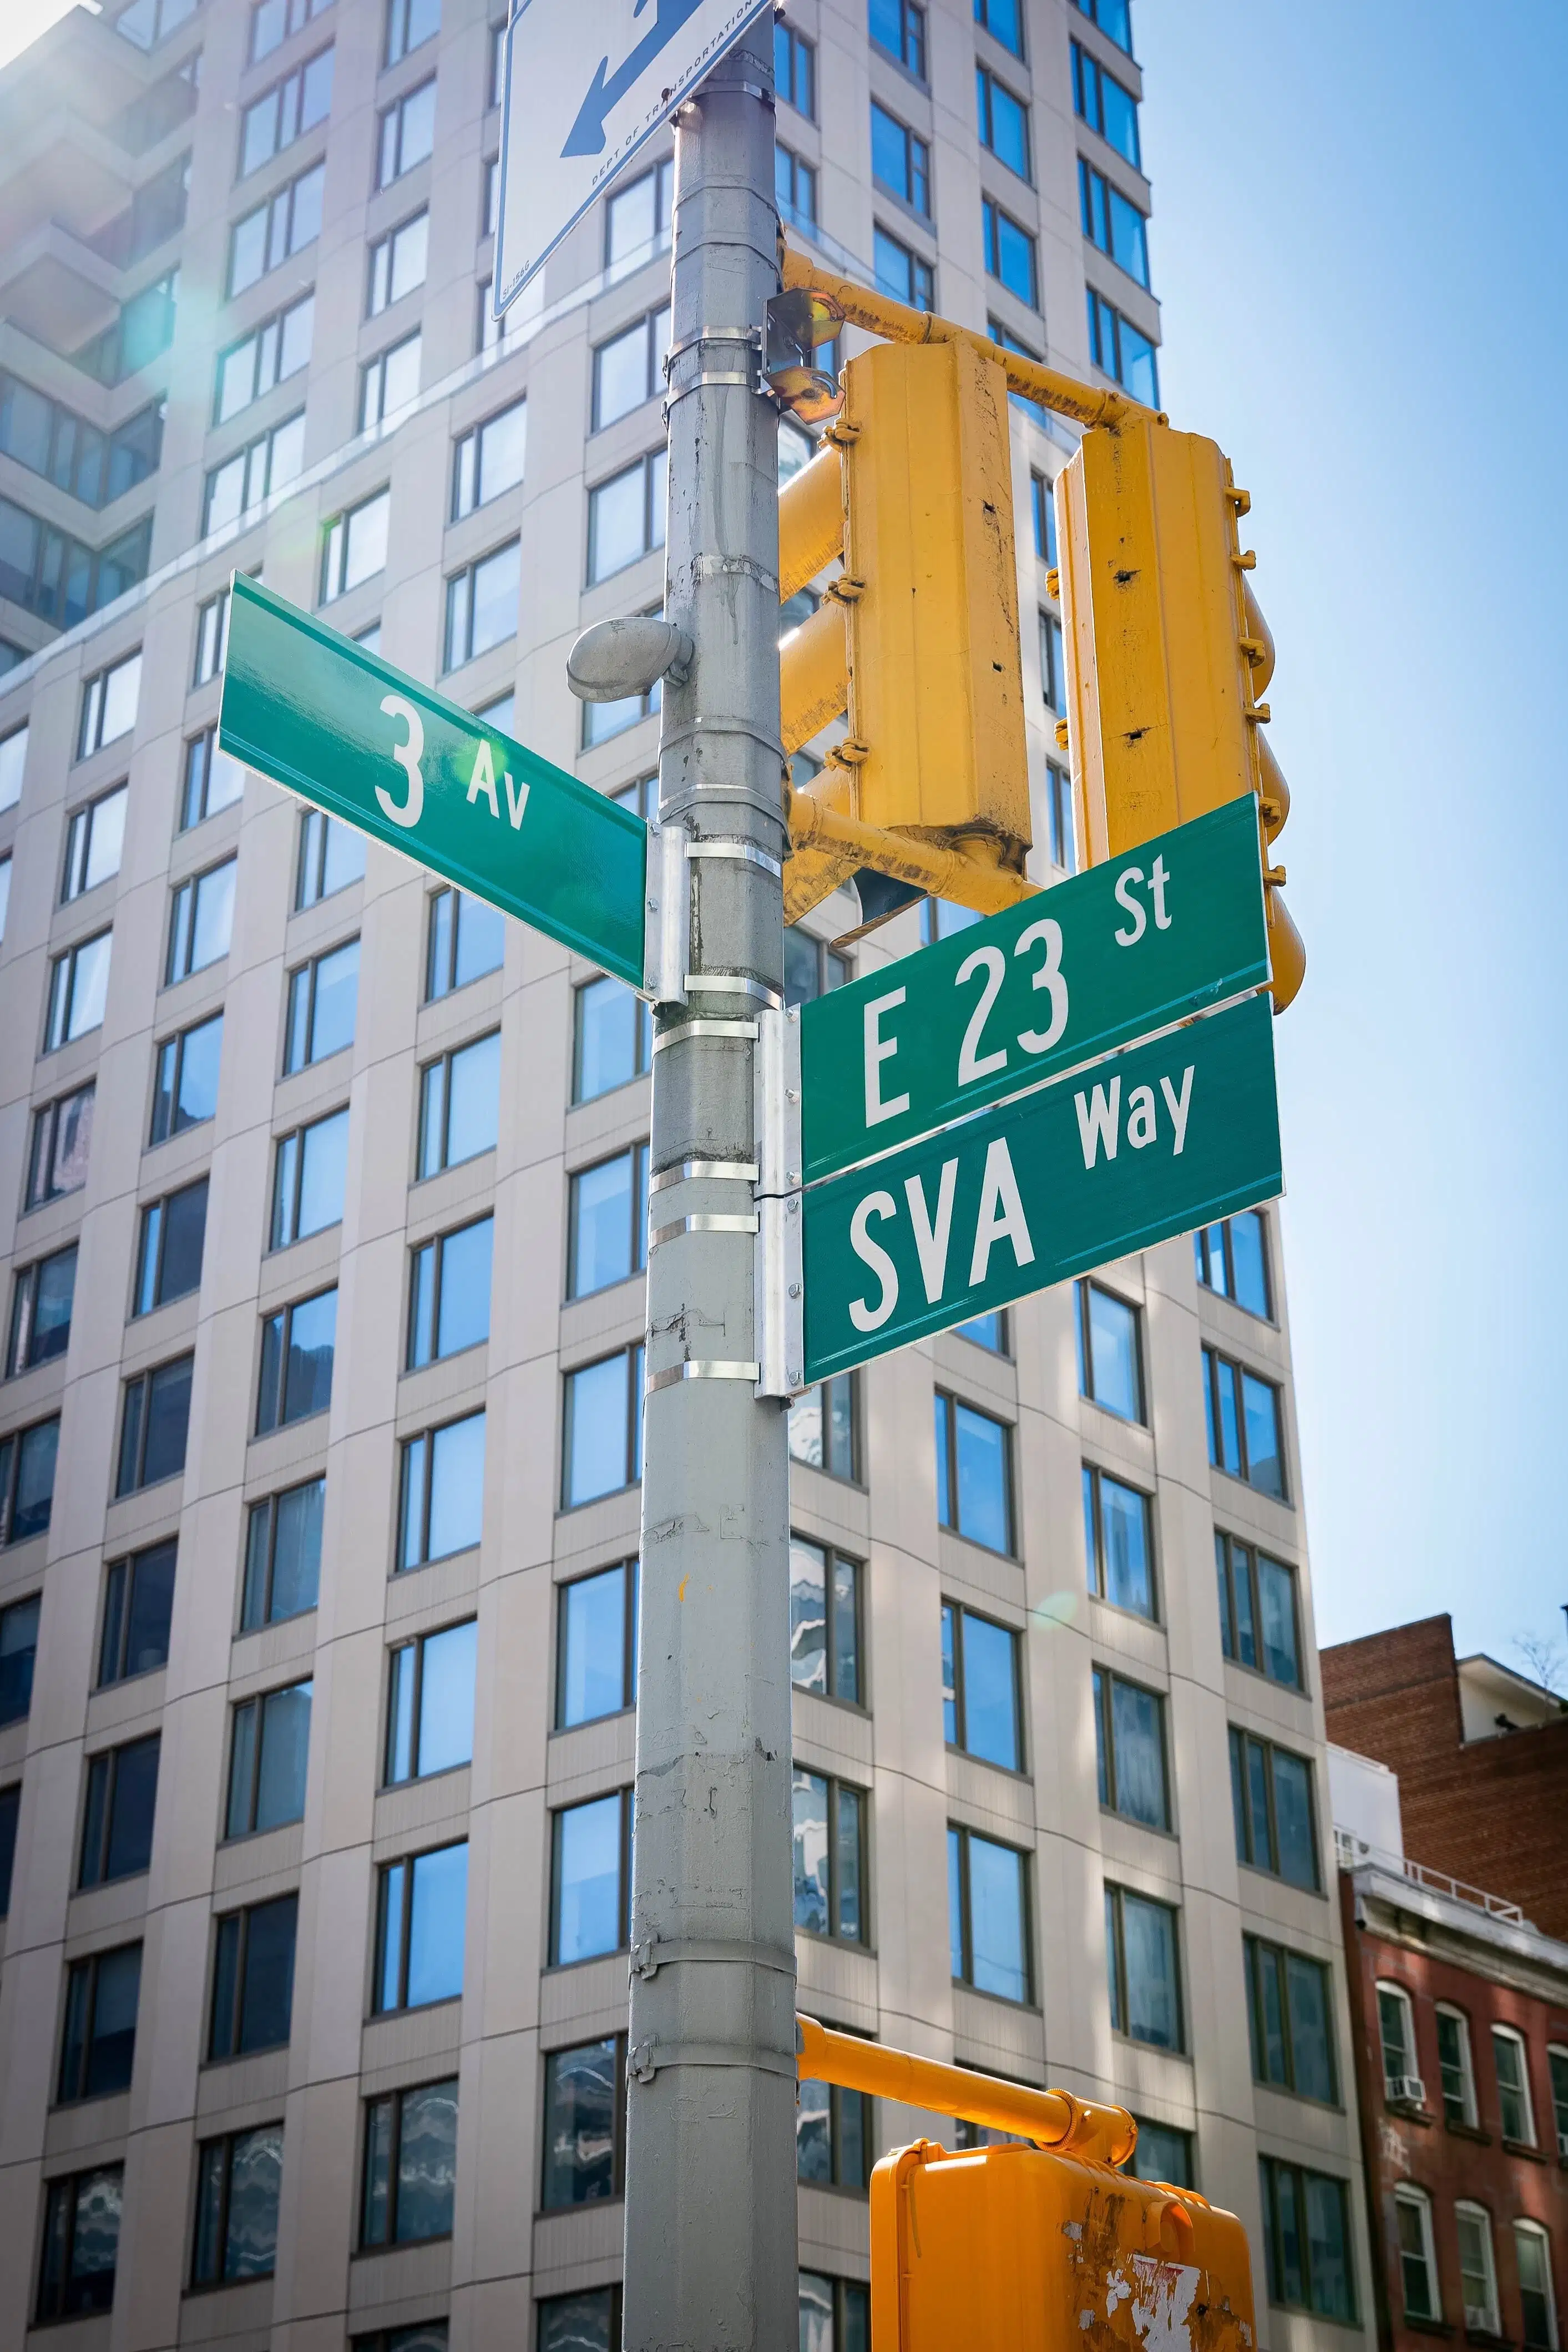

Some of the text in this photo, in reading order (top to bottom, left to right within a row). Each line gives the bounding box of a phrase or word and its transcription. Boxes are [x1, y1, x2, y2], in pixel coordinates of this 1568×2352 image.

[592, 148, 620, 186] DEPT
[625, 125, 639, 145] OF
[375, 695, 530, 831] 3 Av
[864, 853, 1173, 1129] E 23 St
[848, 1064, 1195, 1333] SVA Way
